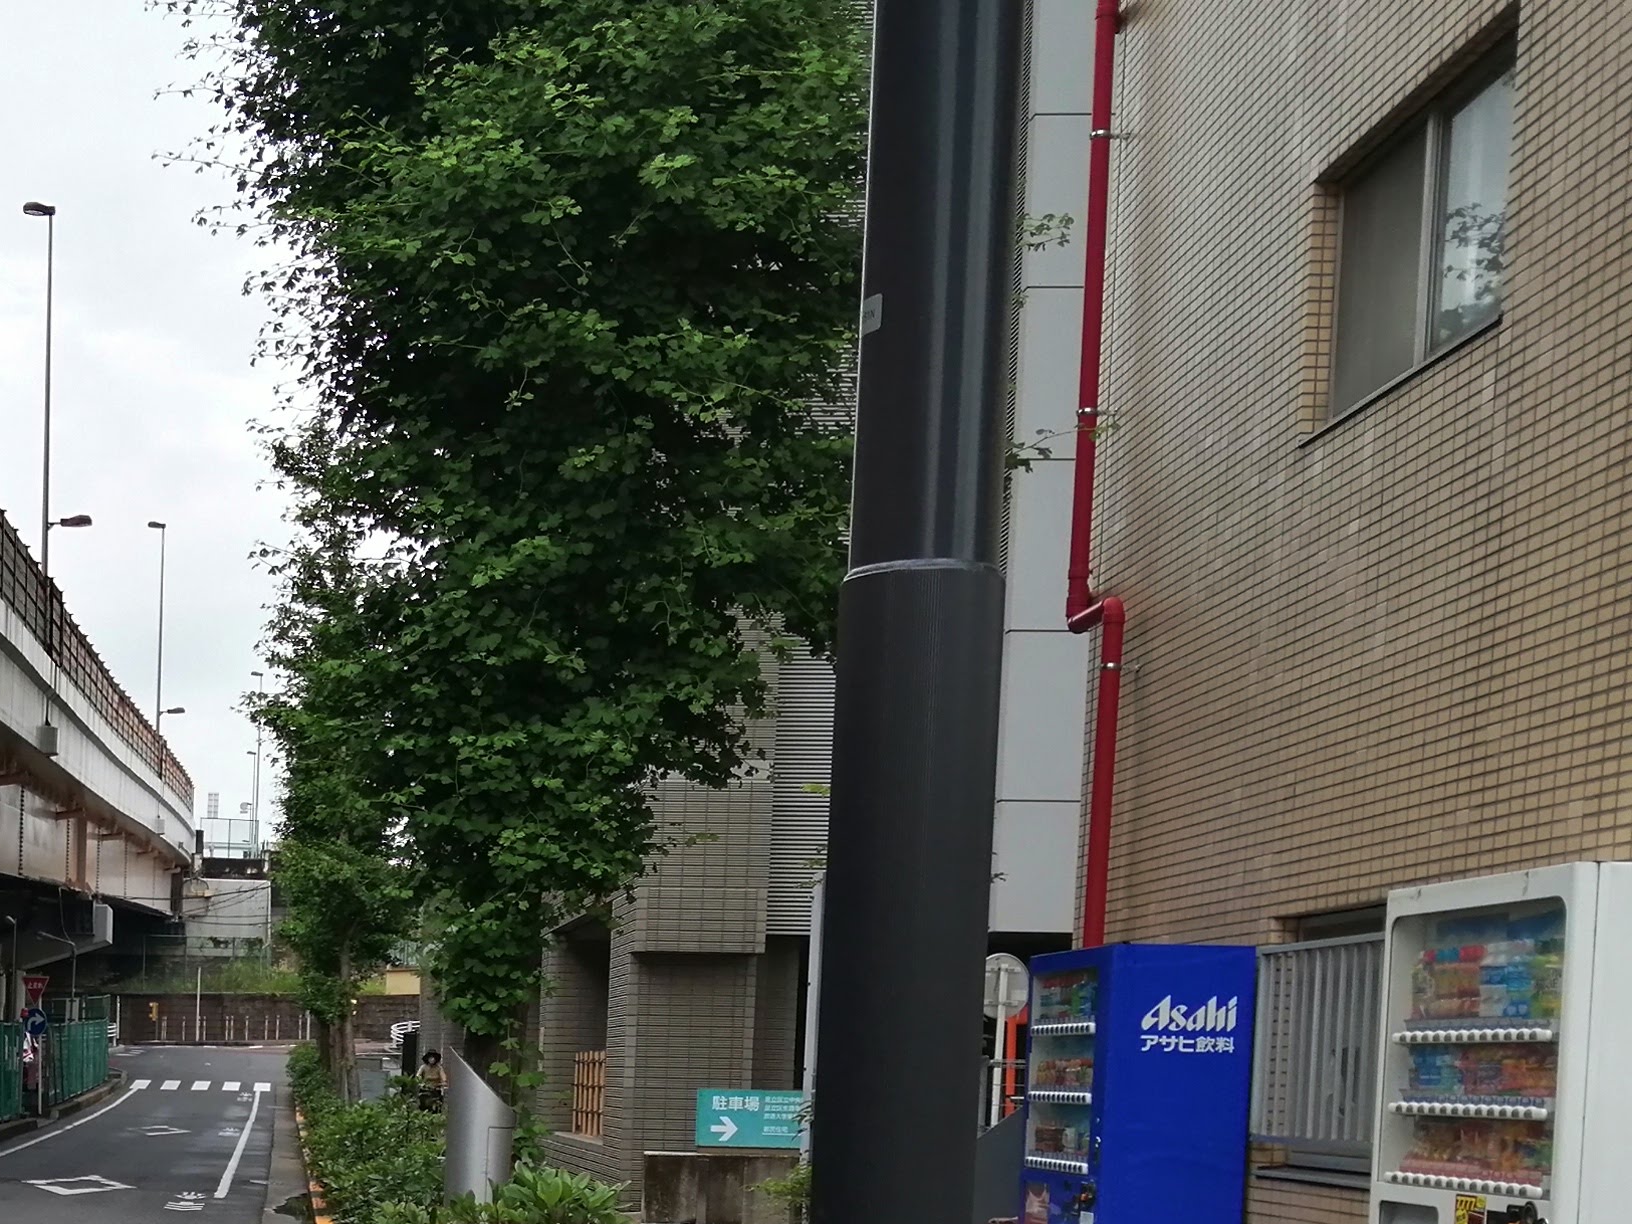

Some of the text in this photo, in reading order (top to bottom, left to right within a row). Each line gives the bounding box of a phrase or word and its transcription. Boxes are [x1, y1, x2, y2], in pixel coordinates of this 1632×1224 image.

[1141, 994, 1238, 1032] Asahi
[1140, 1035, 1235, 1053] アサヒ飲料
[712, 1096, 760, 1112] 駐車場
